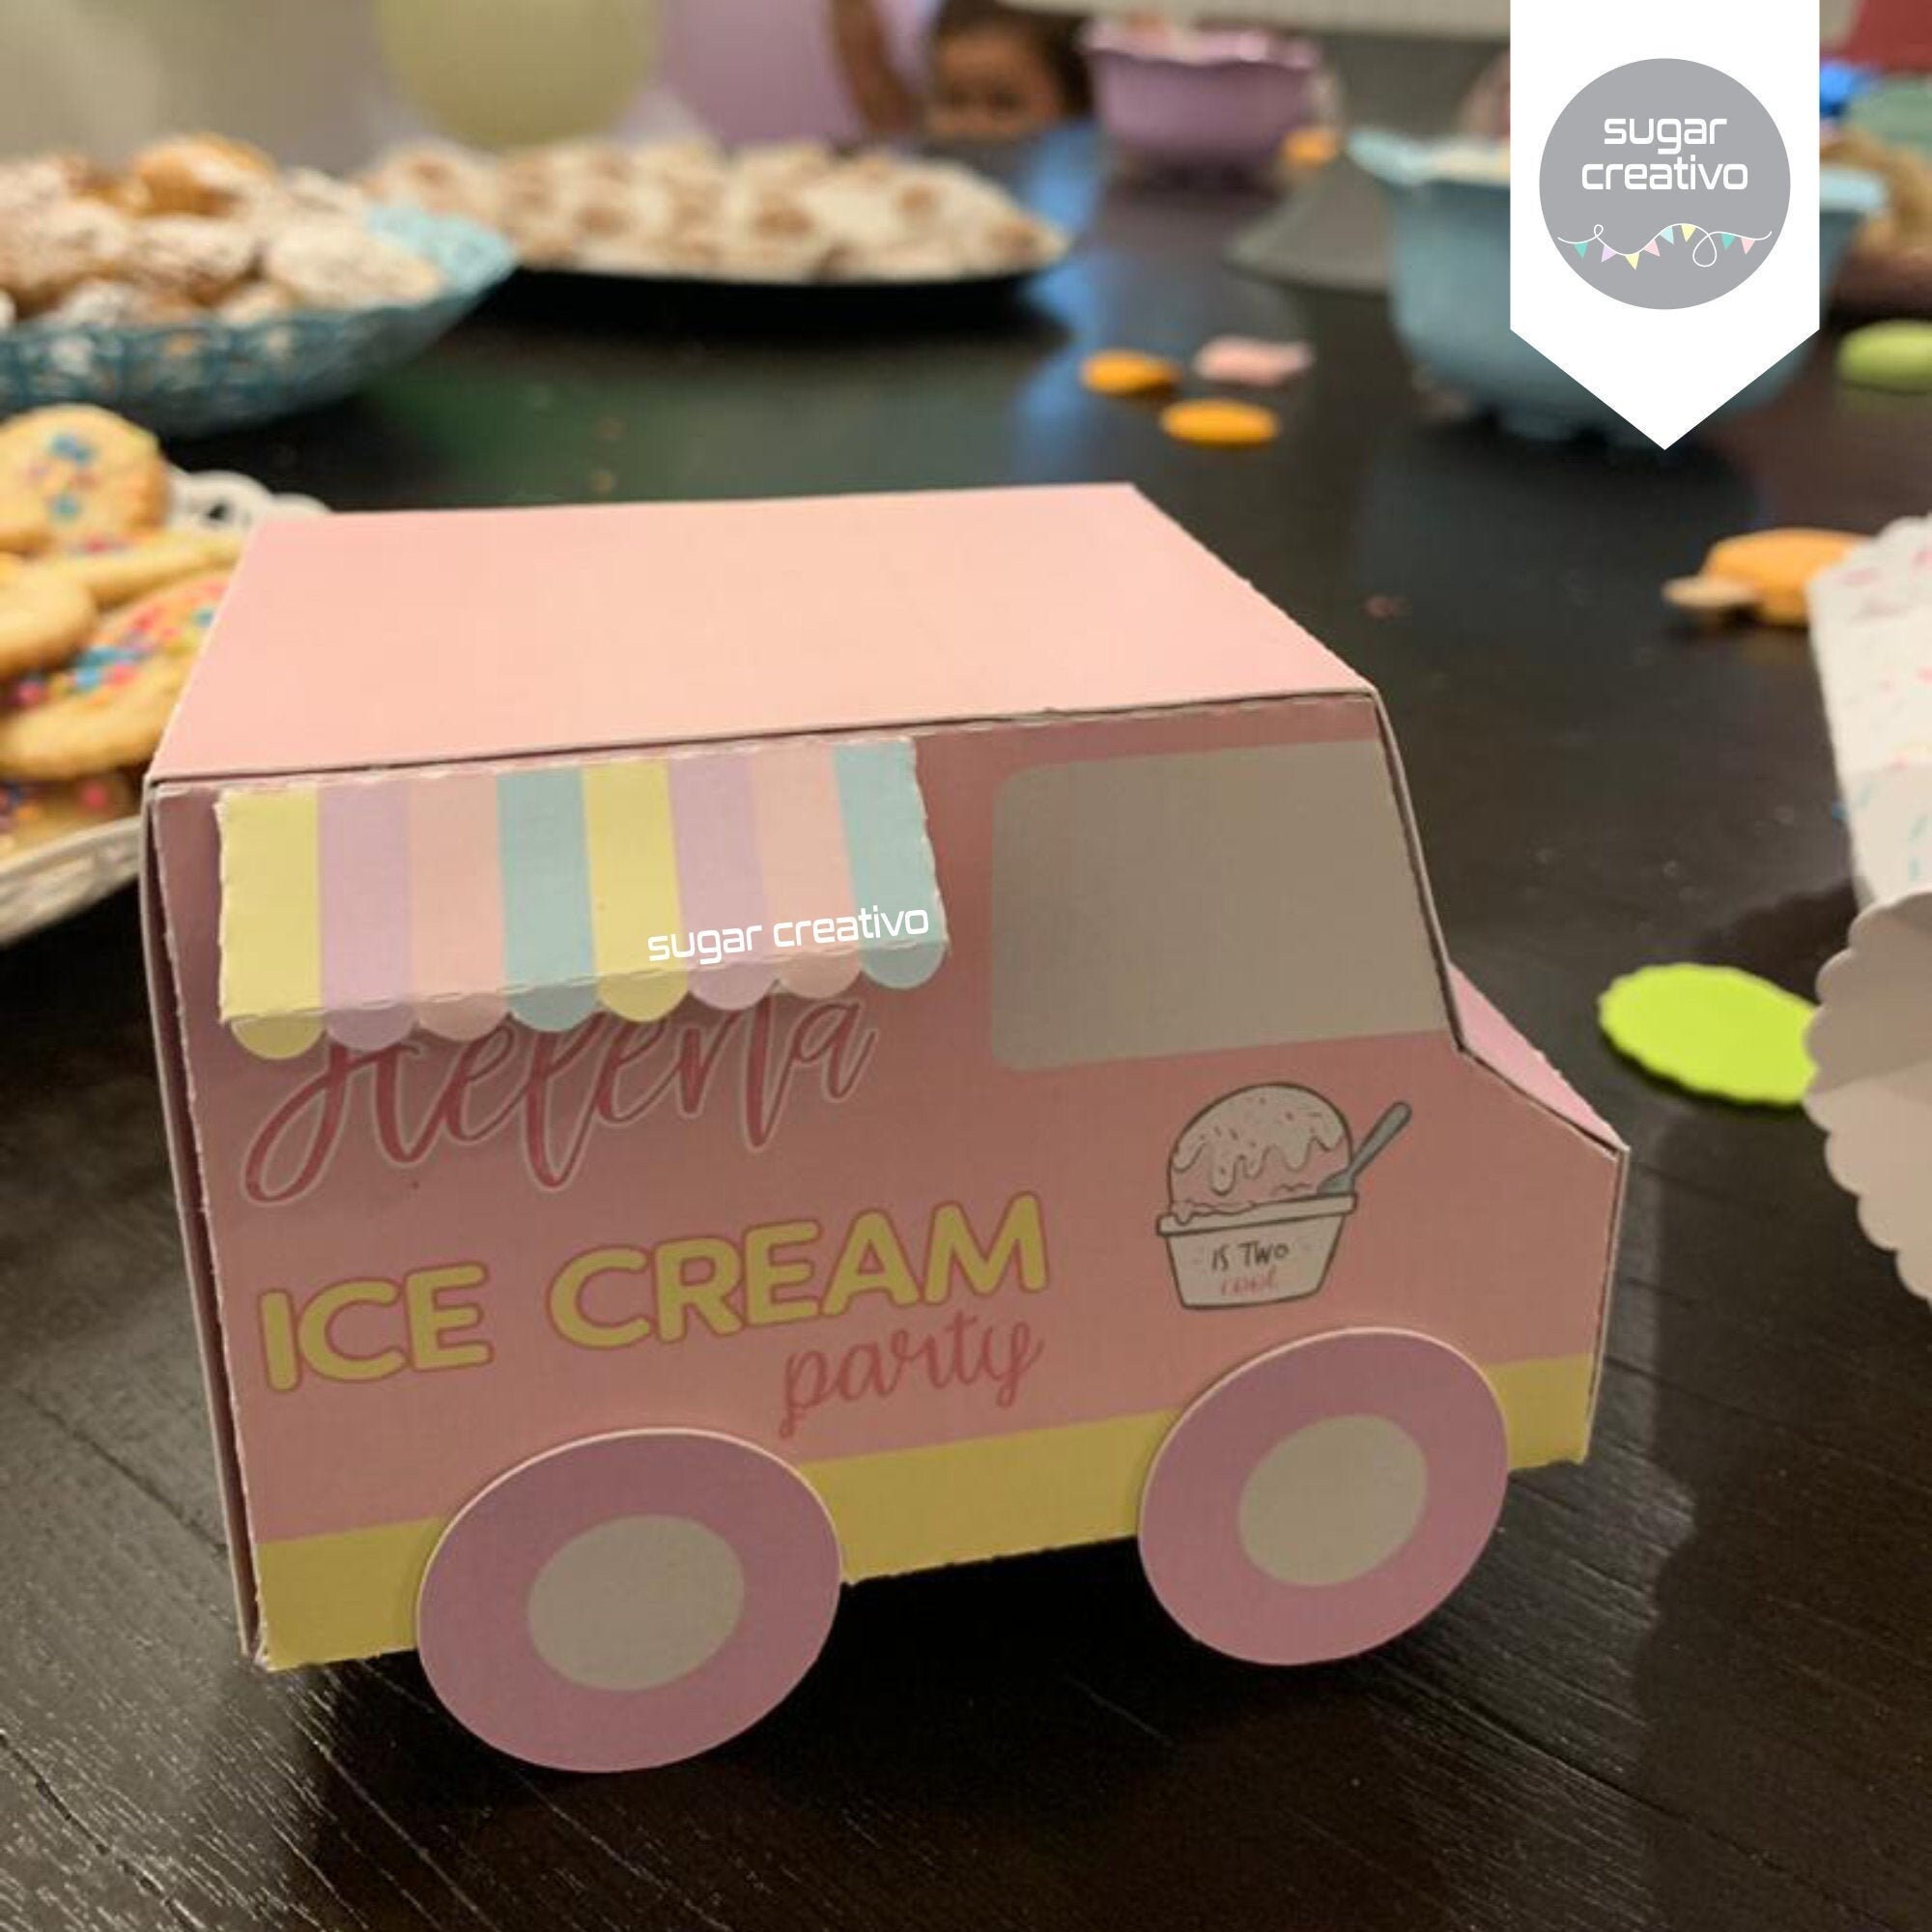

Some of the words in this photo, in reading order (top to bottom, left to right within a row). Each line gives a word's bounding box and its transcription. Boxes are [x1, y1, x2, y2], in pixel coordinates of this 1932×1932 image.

[257, 1262, 495, 1392] ICE
[548, 1191, 1048, 1350] CREAM
[779, 1309, 1044, 1437] party
